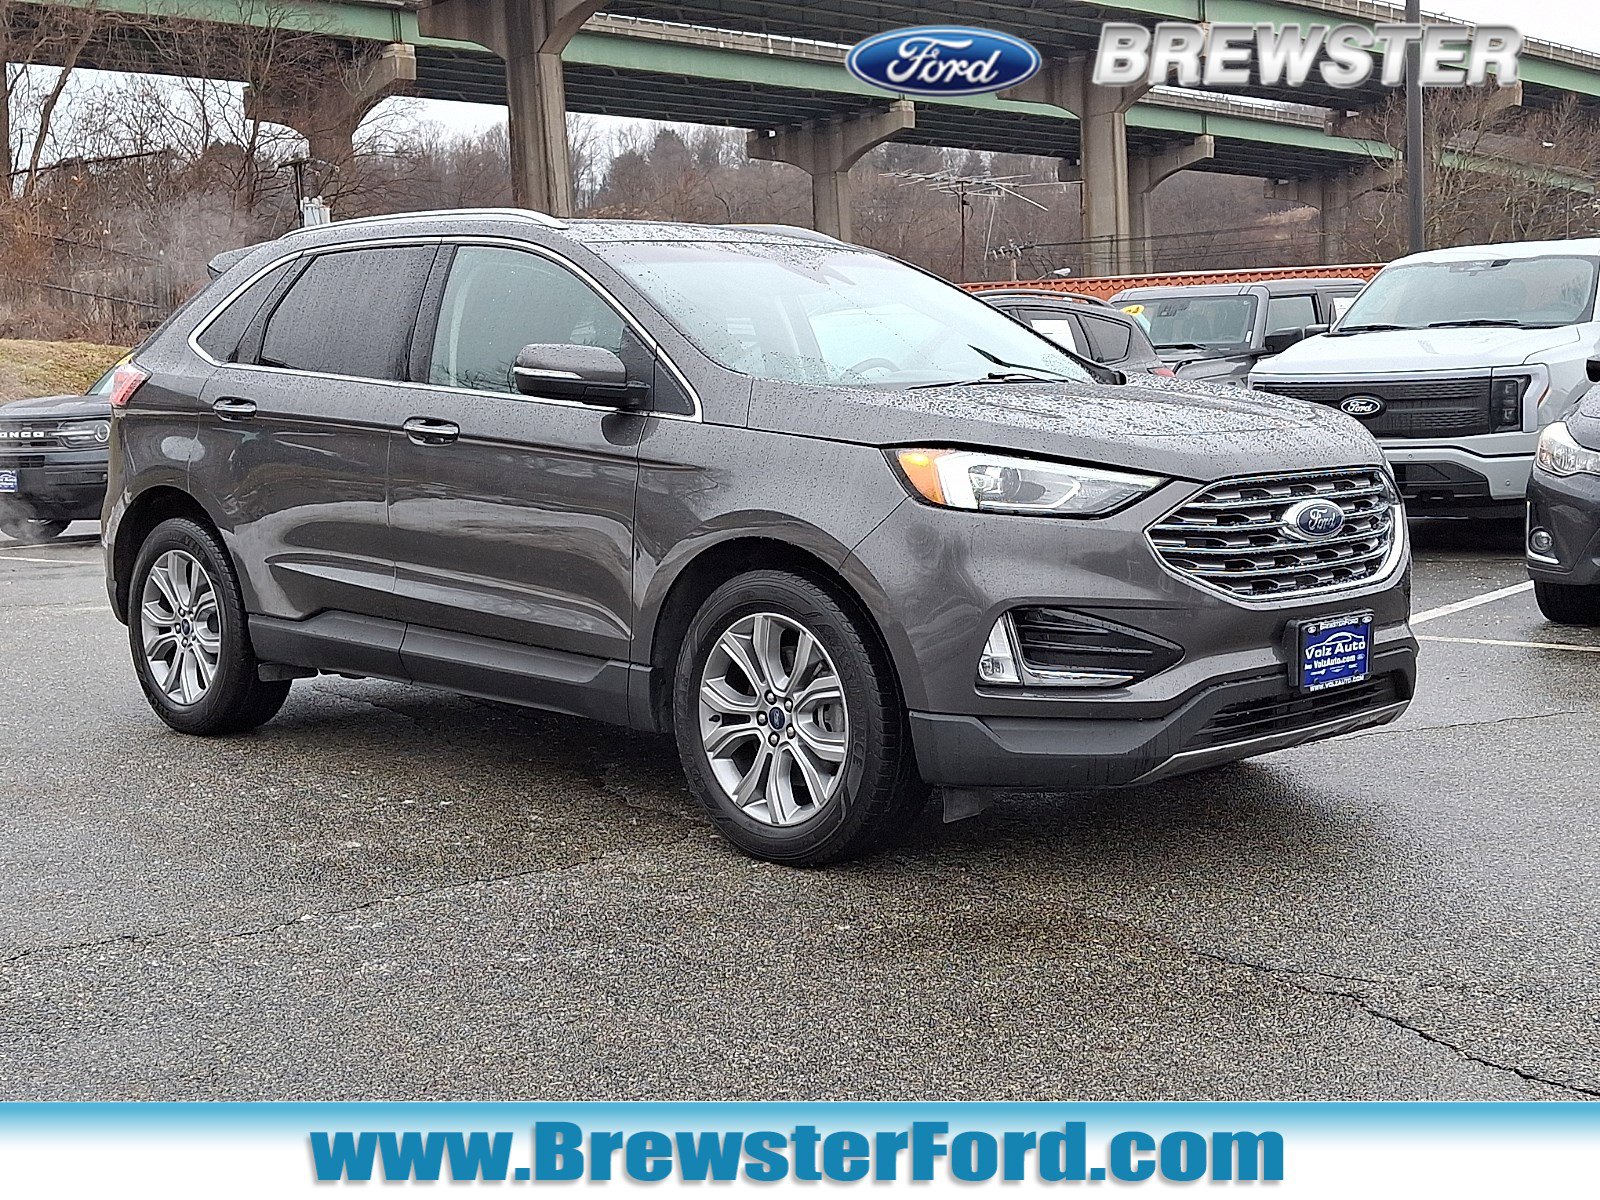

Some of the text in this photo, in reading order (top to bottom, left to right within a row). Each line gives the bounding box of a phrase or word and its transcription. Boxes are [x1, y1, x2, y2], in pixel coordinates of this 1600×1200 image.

[1347, 401, 1373, 412] Ford
[1308, 508, 1336, 531] Ford
[1305, 641, 1366, 660] Volz Auto
